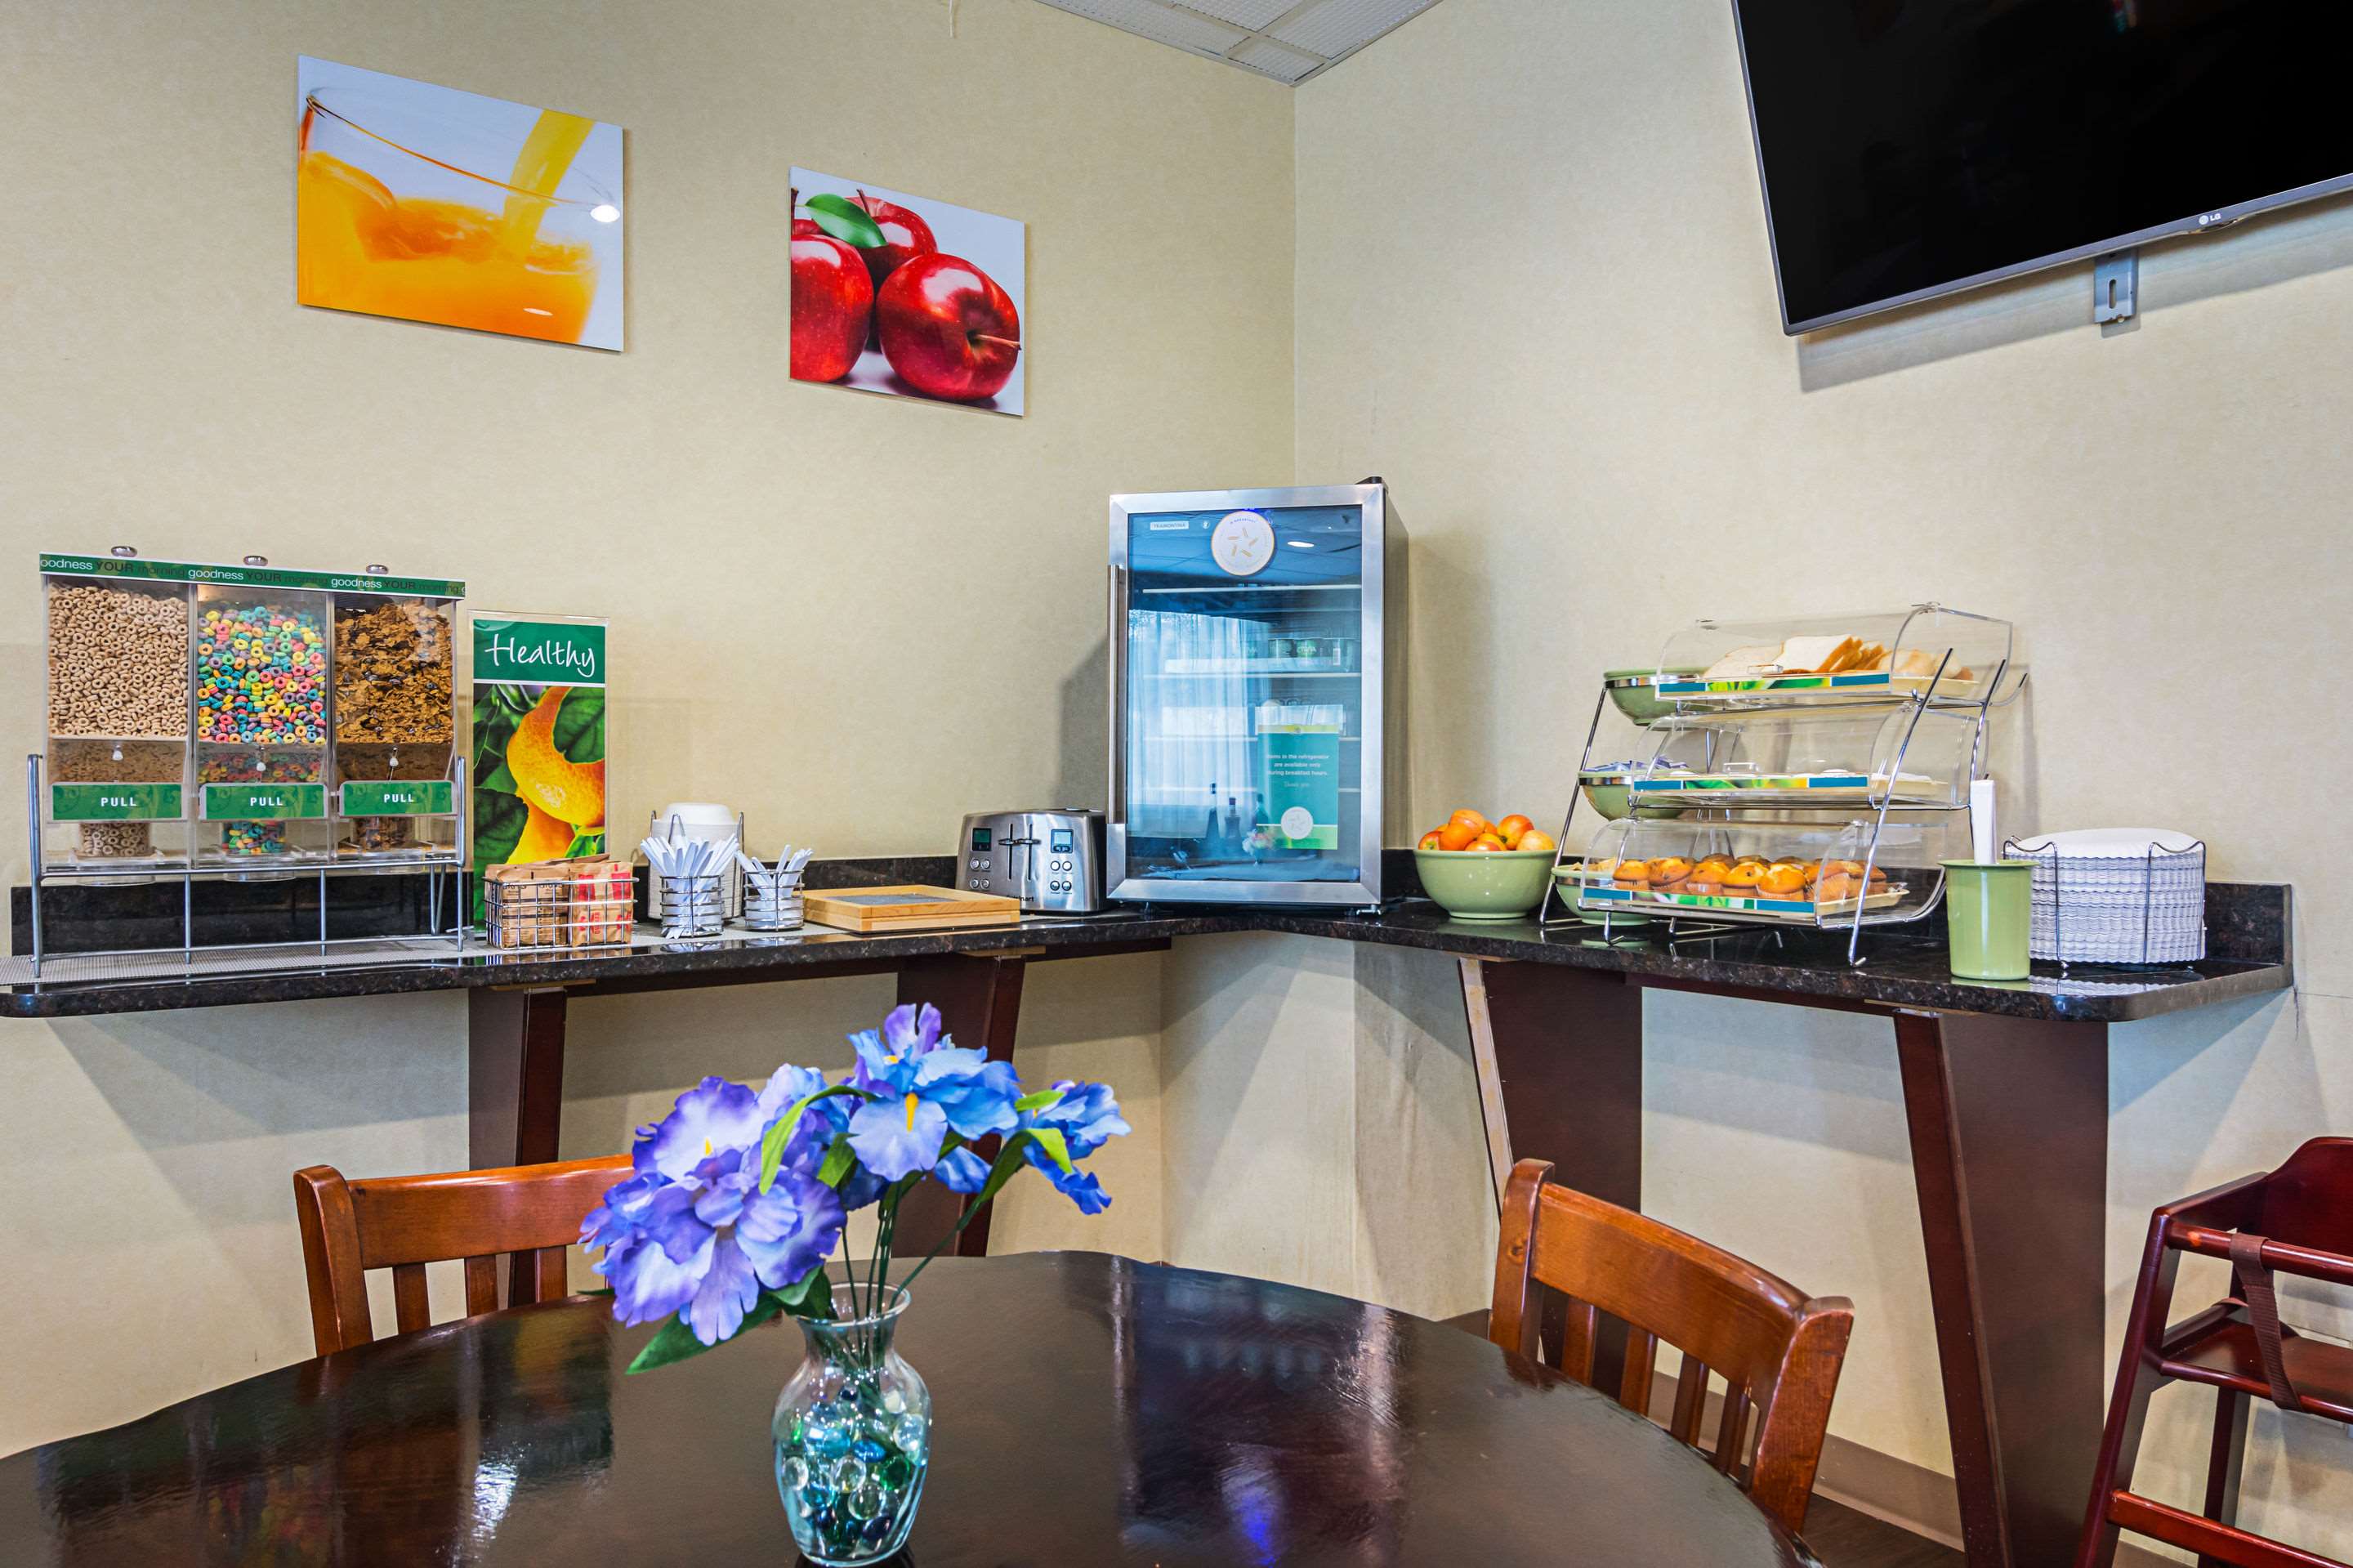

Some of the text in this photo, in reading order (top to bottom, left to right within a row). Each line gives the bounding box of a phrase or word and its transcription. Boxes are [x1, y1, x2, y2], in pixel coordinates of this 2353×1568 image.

[2209, 213, 2221, 221] LG
[96, 561, 133, 572] YOUR
[188, 569, 243, 580] goodness
[246, 572, 282, 582] YOUR
[331, 578, 382, 588] goodness
[384, 581, 416, 590] YOUR
[484, 633, 596, 678] Healthy
[100, 797, 137, 806] PULL
[249, 797, 283, 806] PULL
[383, 793, 414, 803] PULL
